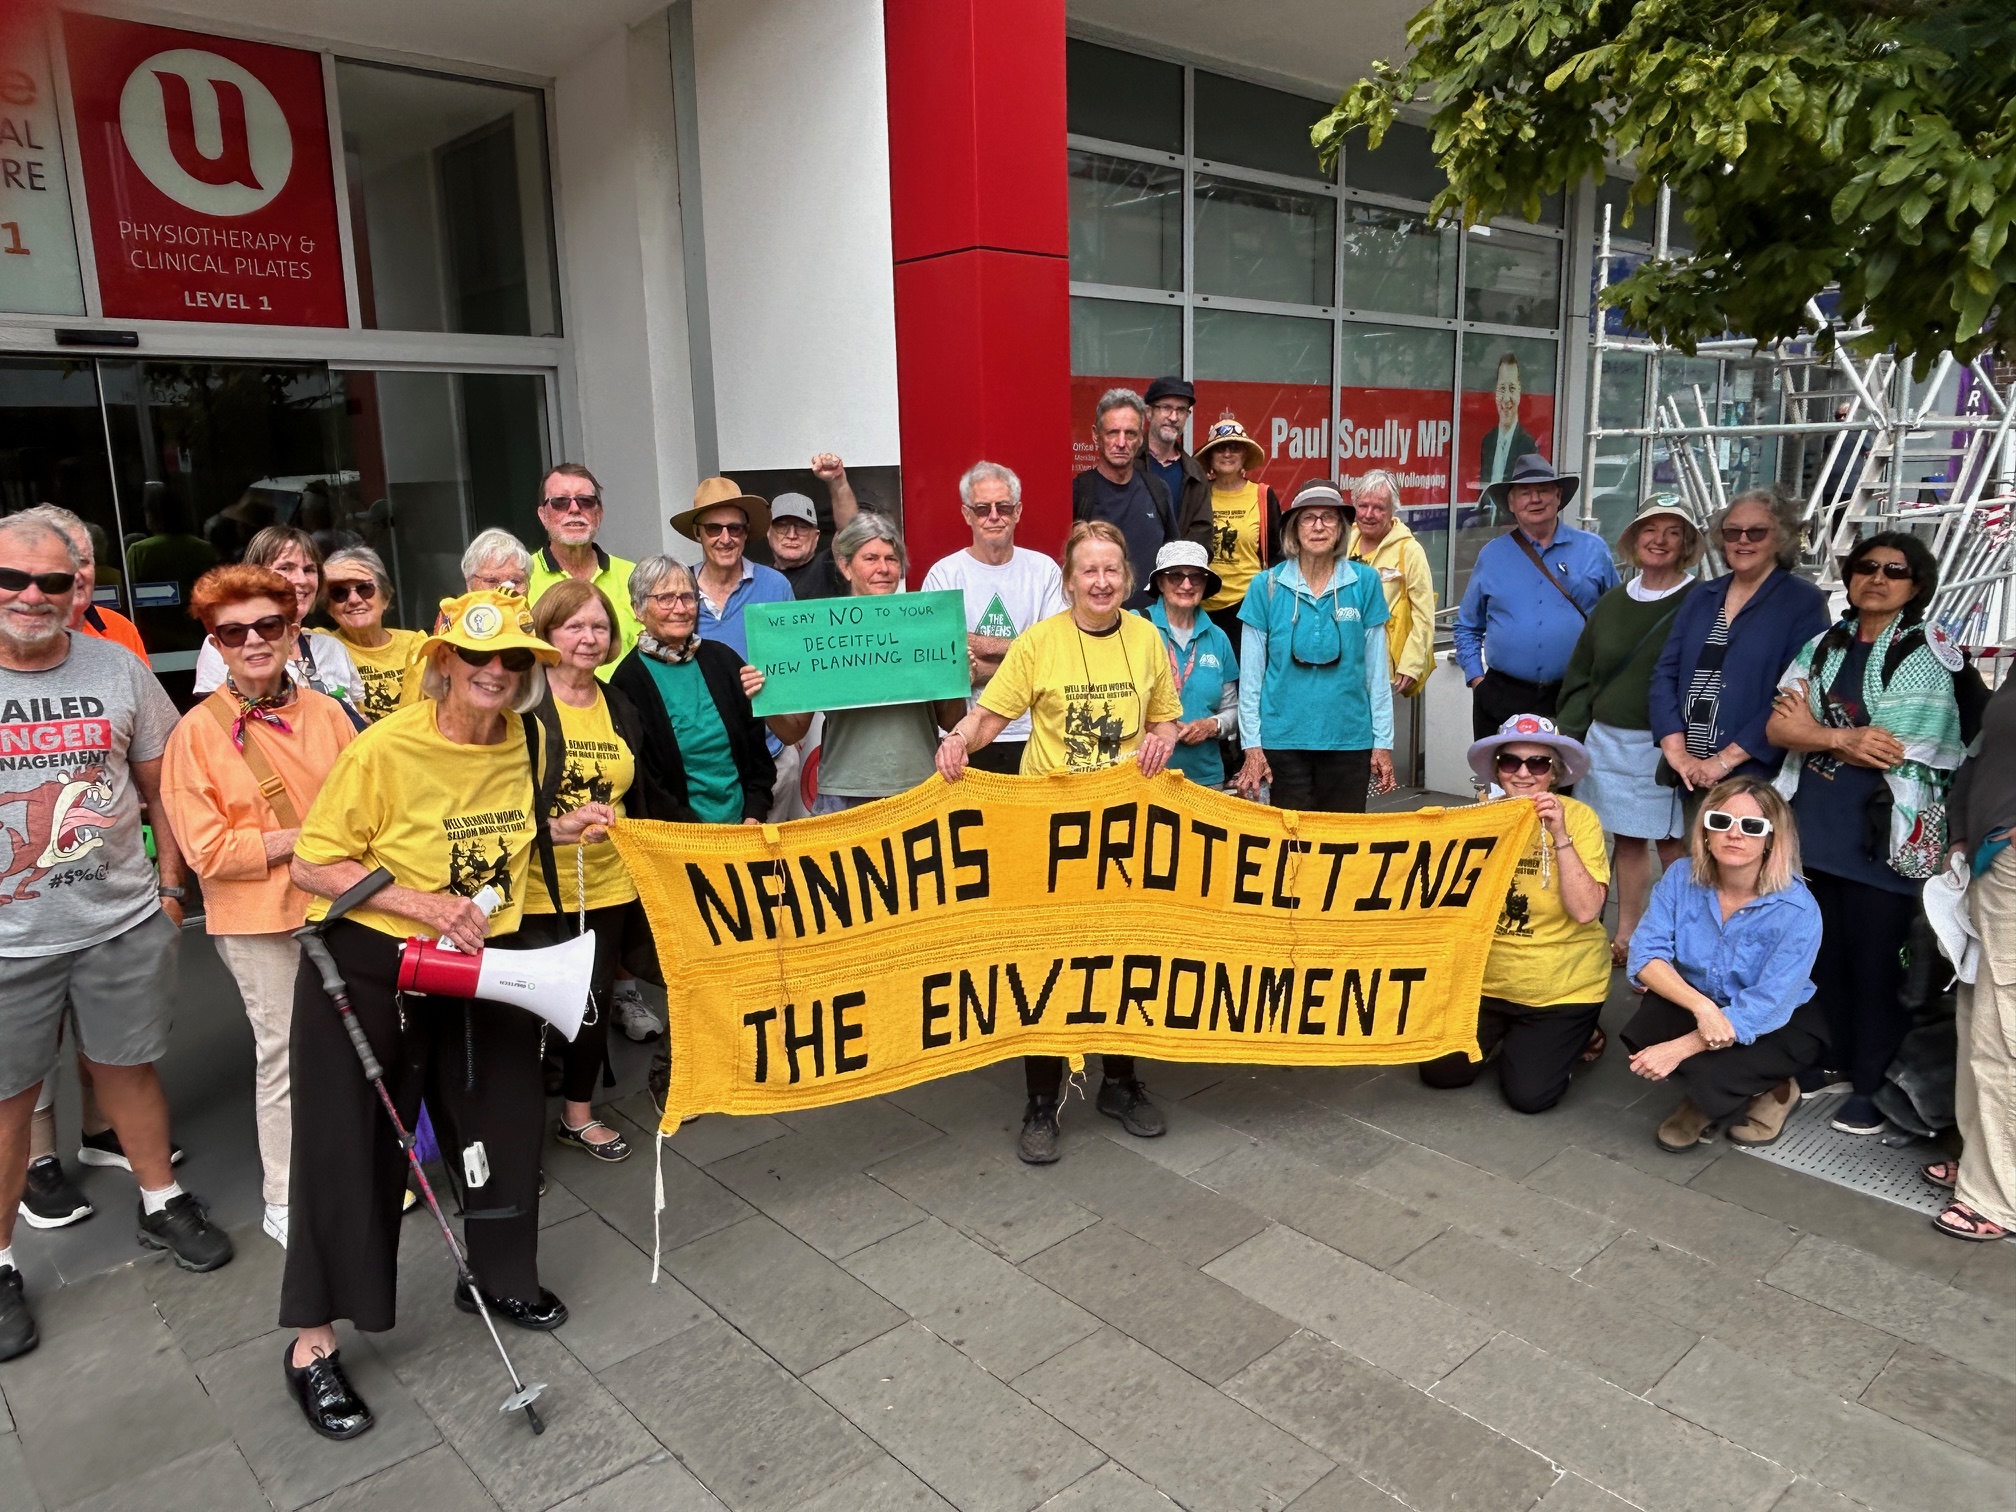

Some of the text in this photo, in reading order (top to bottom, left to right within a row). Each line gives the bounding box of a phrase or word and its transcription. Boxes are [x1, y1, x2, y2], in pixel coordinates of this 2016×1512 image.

[119, 221, 316, 254] PHYSIOTHERAPY &
[130, 250, 312, 279] CLINICAL PILATES
[184, 290, 272, 310] LEVEL 1
[1271, 417, 1451, 465] Paul Scully MP
[1396, 472, 1446, 490] Wollongong
[768, 605, 934, 627] WE SAY NO TO YOUR
[988, 613, 1004, 625] THE
[803, 632, 899, 652] DECEITFUL
[765, 661, 801, 676] NEW
[811, 650, 902, 672] PLANNING
[493, 809, 524, 824] WOMEN
[685, 802, 1497, 946] NANNAS PROTECTING
[744, 955, 1427, 1084] THE ENVIRONMENT
